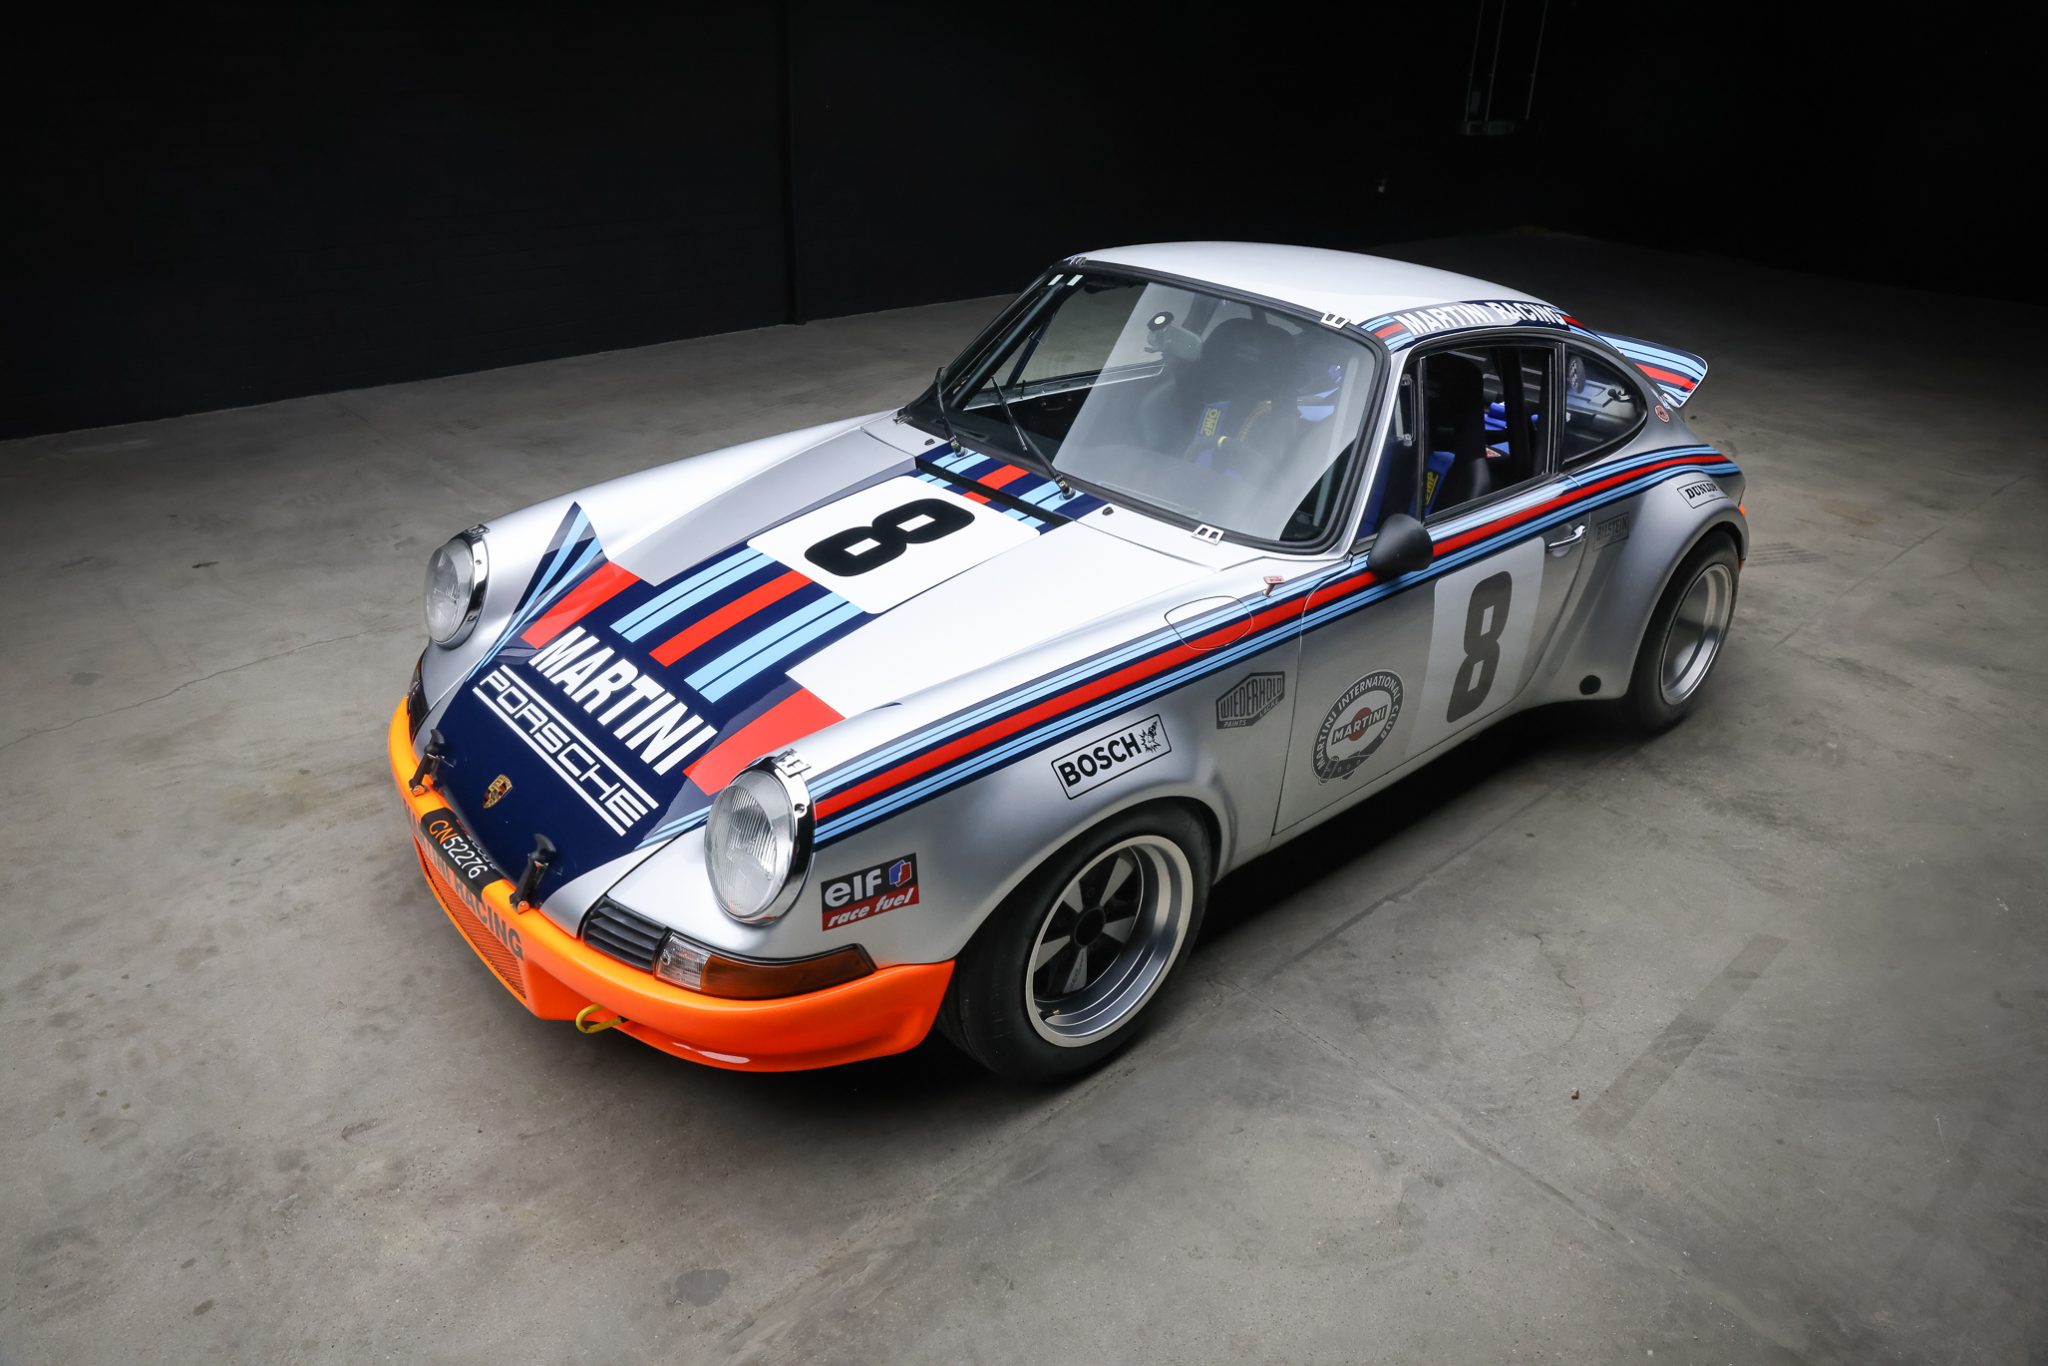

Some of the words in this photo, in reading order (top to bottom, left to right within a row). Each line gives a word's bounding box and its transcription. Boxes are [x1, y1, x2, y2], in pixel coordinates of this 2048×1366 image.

[1393, 303, 1495, 336] MARTINI
[1484, 302, 1567, 326] RACING
[804, 498, 976, 577] 8
[1447, 571, 1512, 723] 8
[528, 626, 718, 776] MARTINI
[1220, 677, 1282, 719] WIEDERHOLD
[1316, 711, 1337, 770] MARTINI
[1338, 675, 1401, 711] INTERNATIONAL
[1380, 705, 1399, 739] CLUB
[1333, 707, 1386, 743] MARTINI
[479, 670, 649, 828] PORSCHE
[1058, 732, 1142, 788] BOSCH
[429, 820, 487, 879] CN52276
[825, 868, 882, 907] elf
[828, 906, 870, 927] race
[875, 887, 914, 912] fuel
